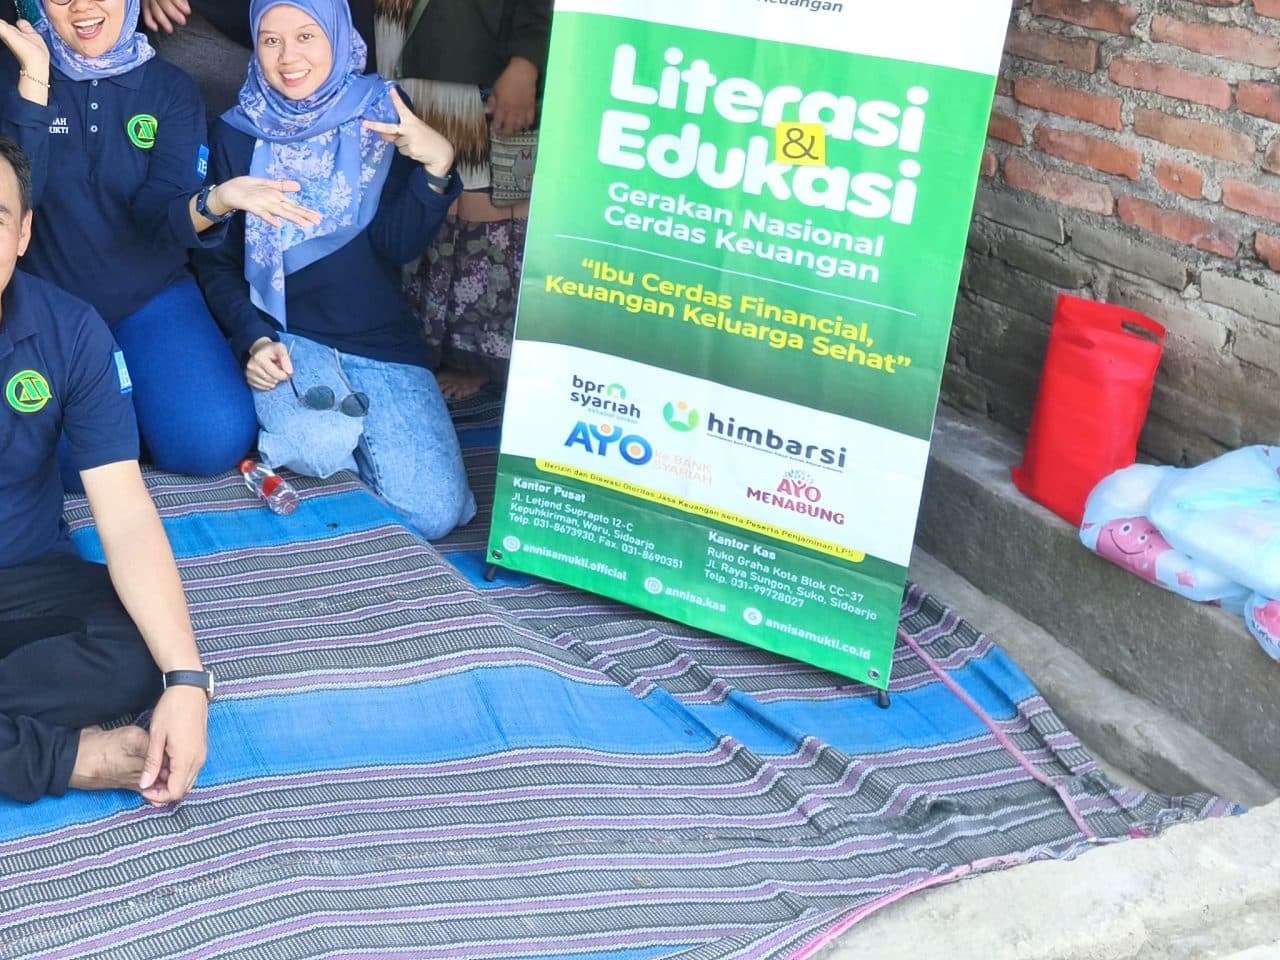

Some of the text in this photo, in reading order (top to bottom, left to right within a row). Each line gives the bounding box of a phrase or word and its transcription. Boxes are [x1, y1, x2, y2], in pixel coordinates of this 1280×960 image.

[609, 43, 930, 153] Literasi
[780, 126, 819, 161] &
[597, 108, 922, 226] Edukasi
[608, 182, 885, 258] Gerakan Nasional
[604, 204, 880, 283] Cerdas Keuangan
[544, 274, 676, 320] Keuangan
[682, 304, 805, 353] Keluarga
[641, 271, 732, 310] Cerdas
[740, 293, 874, 348] Financial,
[572, 374, 605, 394] bpr
[570, 391, 641, 420] syariah
[564, 420, 654, 466] AYO
[707, 411, 847, 468] himbarsi
[513, 477, 587, 503] Kantor Pusat
[746, 486, 846, 526] MENABUNG
[776, 478, 822, 503] AYO
[525, 494, 563, 512] Letjend
[564, 503, 610, 525] Suprapto
[611, 517, 635, 532] 12-C
[613, 528, 655, 552] Sidoarjo
[621, 543, 684, 570] 031-8690351
[708, 530, 777, 561] Kantor Kas
[522, 543, 628, 582] annisamukti.official
[707, 546, 865, 604] Ruko Graha Kota Blok CC-37
[664, 584, 728, 614] annisa.kas
[720, 563, 748, 581] Raya
[830, 597, 878, 621] Sidoarjo
[764, 617, 872, 660] annisamukti.co.id
